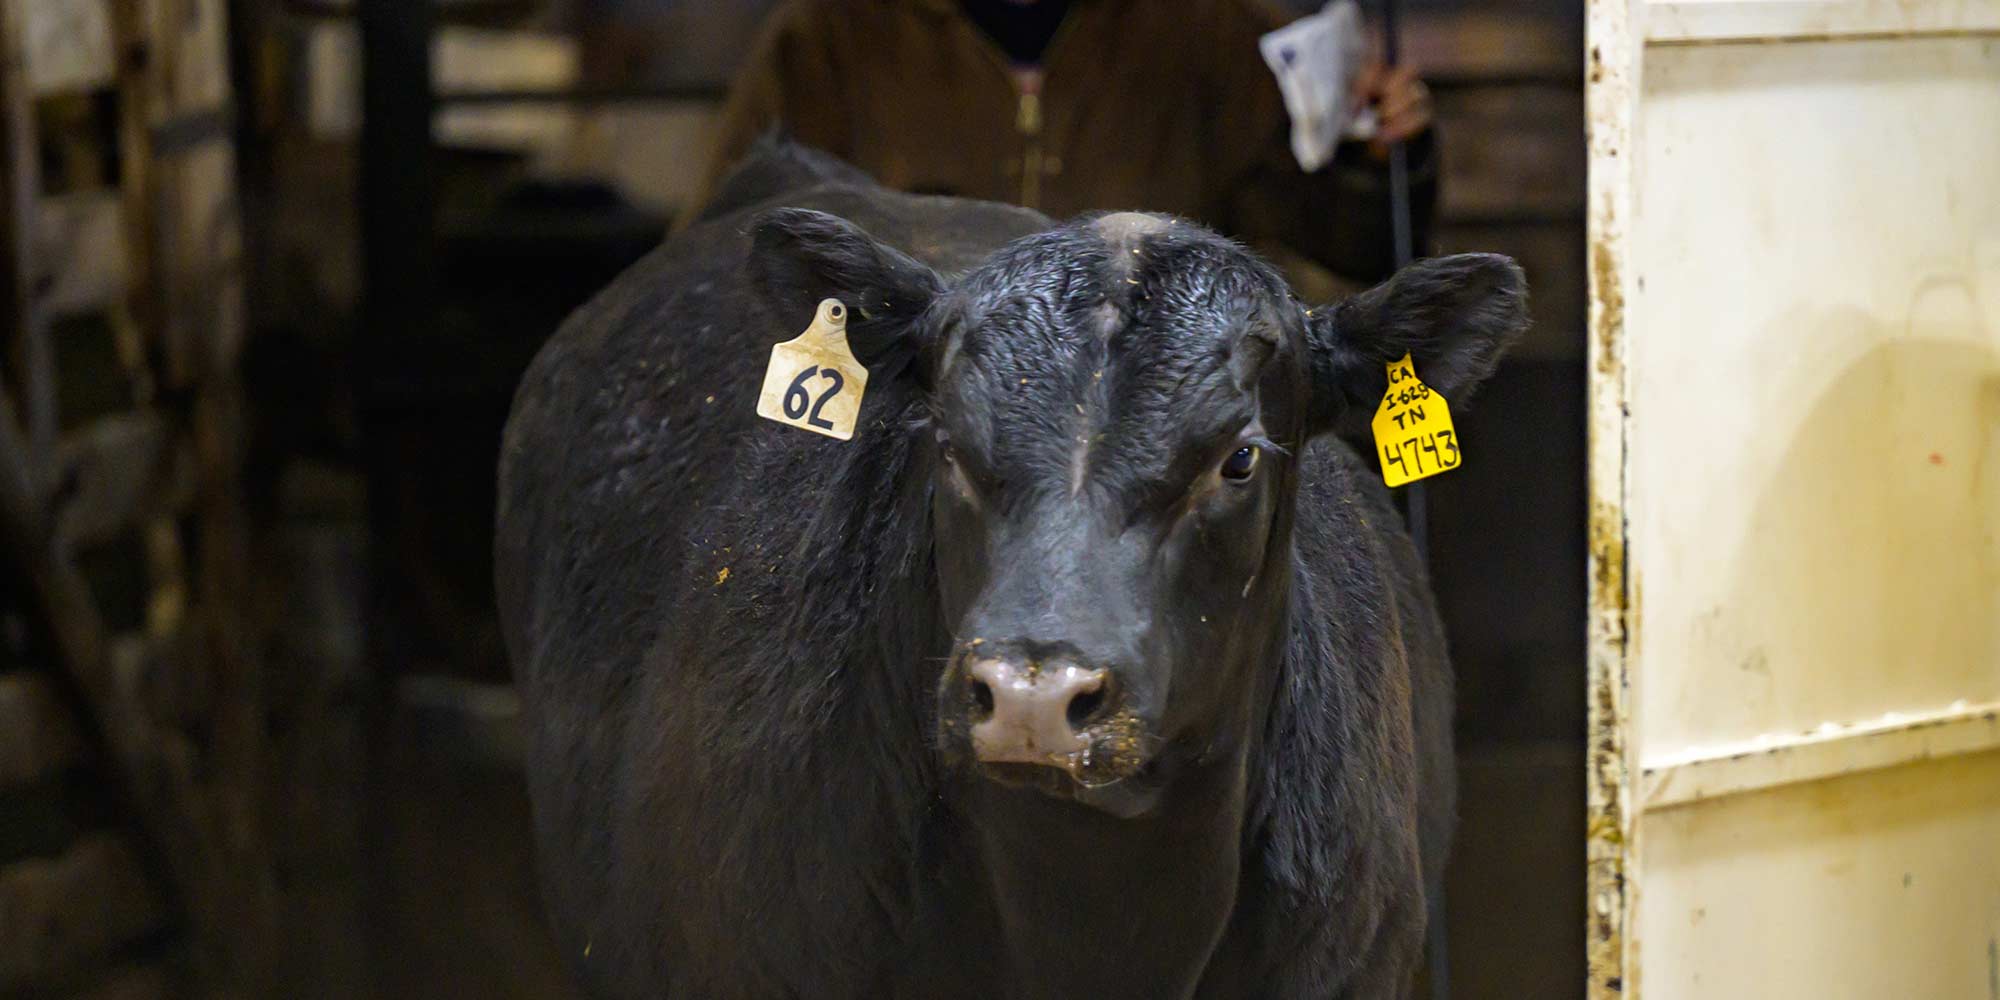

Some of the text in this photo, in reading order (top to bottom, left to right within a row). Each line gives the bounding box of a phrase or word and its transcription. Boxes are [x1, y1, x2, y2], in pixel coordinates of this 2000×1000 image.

[1390, 366, 1413, 384] CA
[783, 365, 845, 431] 62
[1392, 405, 1426, 430] TN
[1384, 430, 1458, 477] 4743
